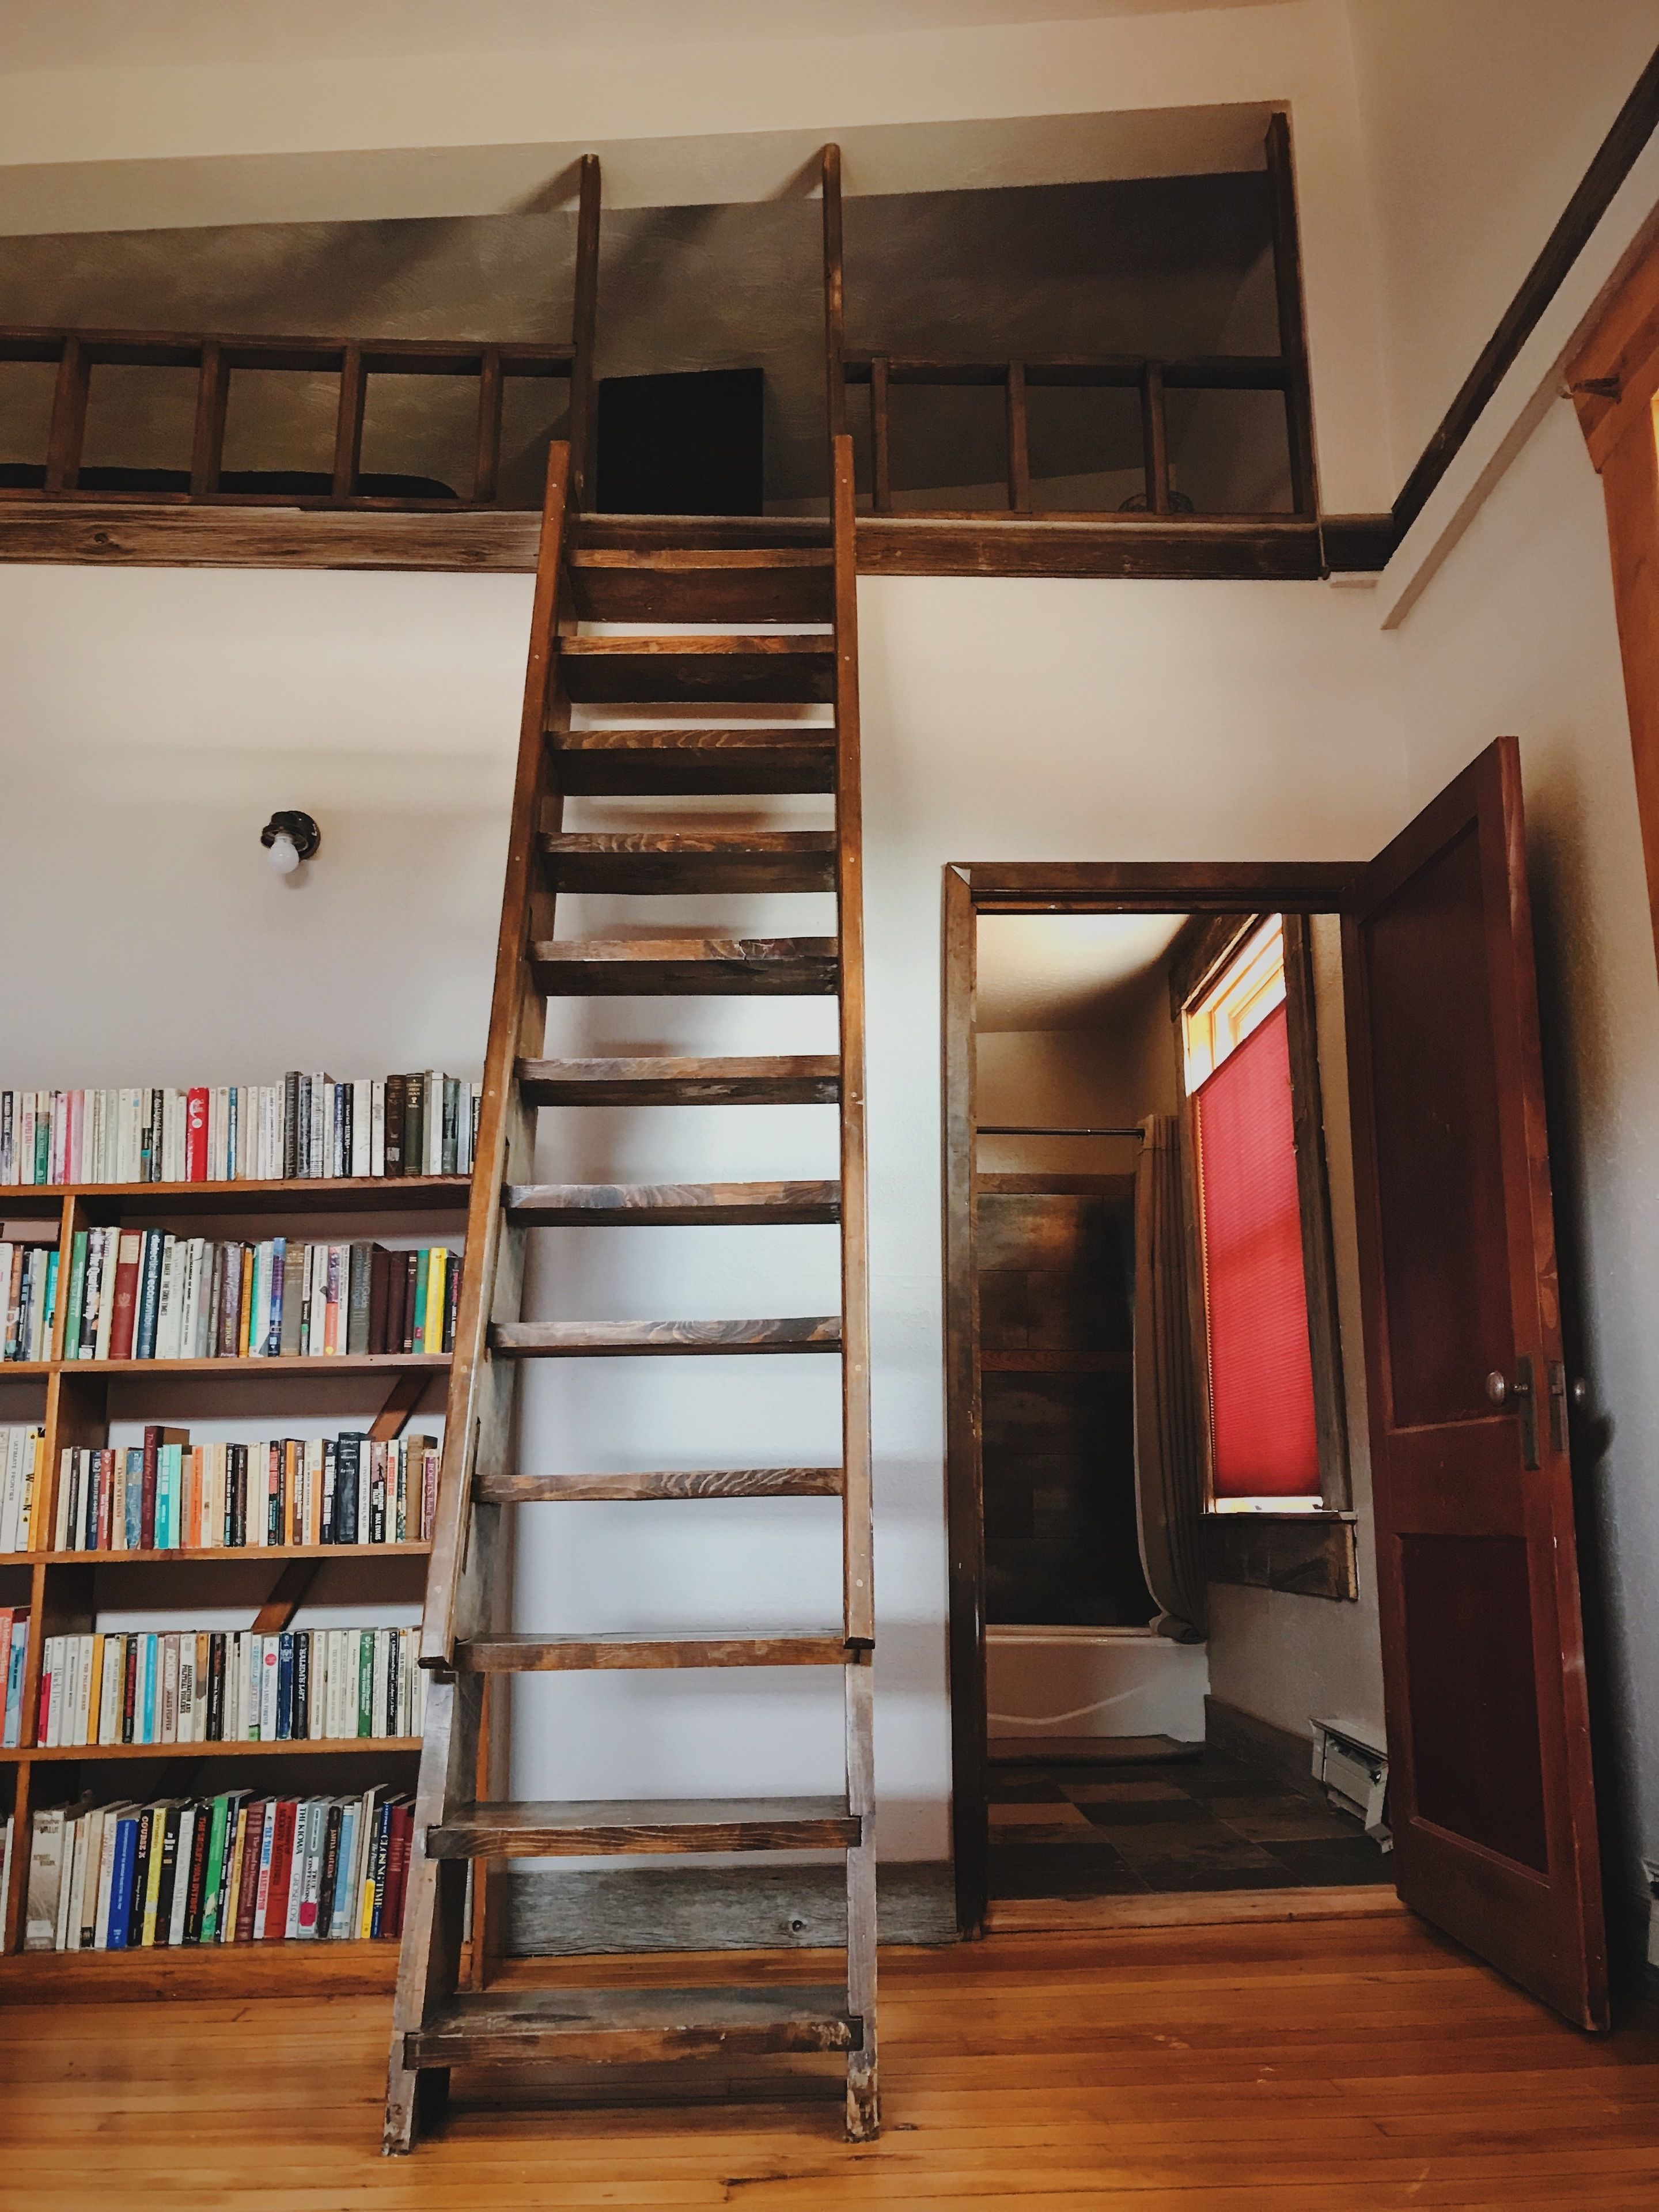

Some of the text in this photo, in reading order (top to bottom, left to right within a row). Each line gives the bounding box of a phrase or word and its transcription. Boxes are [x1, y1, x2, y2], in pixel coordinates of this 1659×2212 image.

[165, 1648, 176, 1690] ACKROYD
[296, 1825, 305, 1854] KIOWA
[258, 1870, 270, 1911] WASHINGTON
[374, 1835, 388, 1909] CLOSING TIME
[289, 1873, 299, 1922] GROSECLOSE
